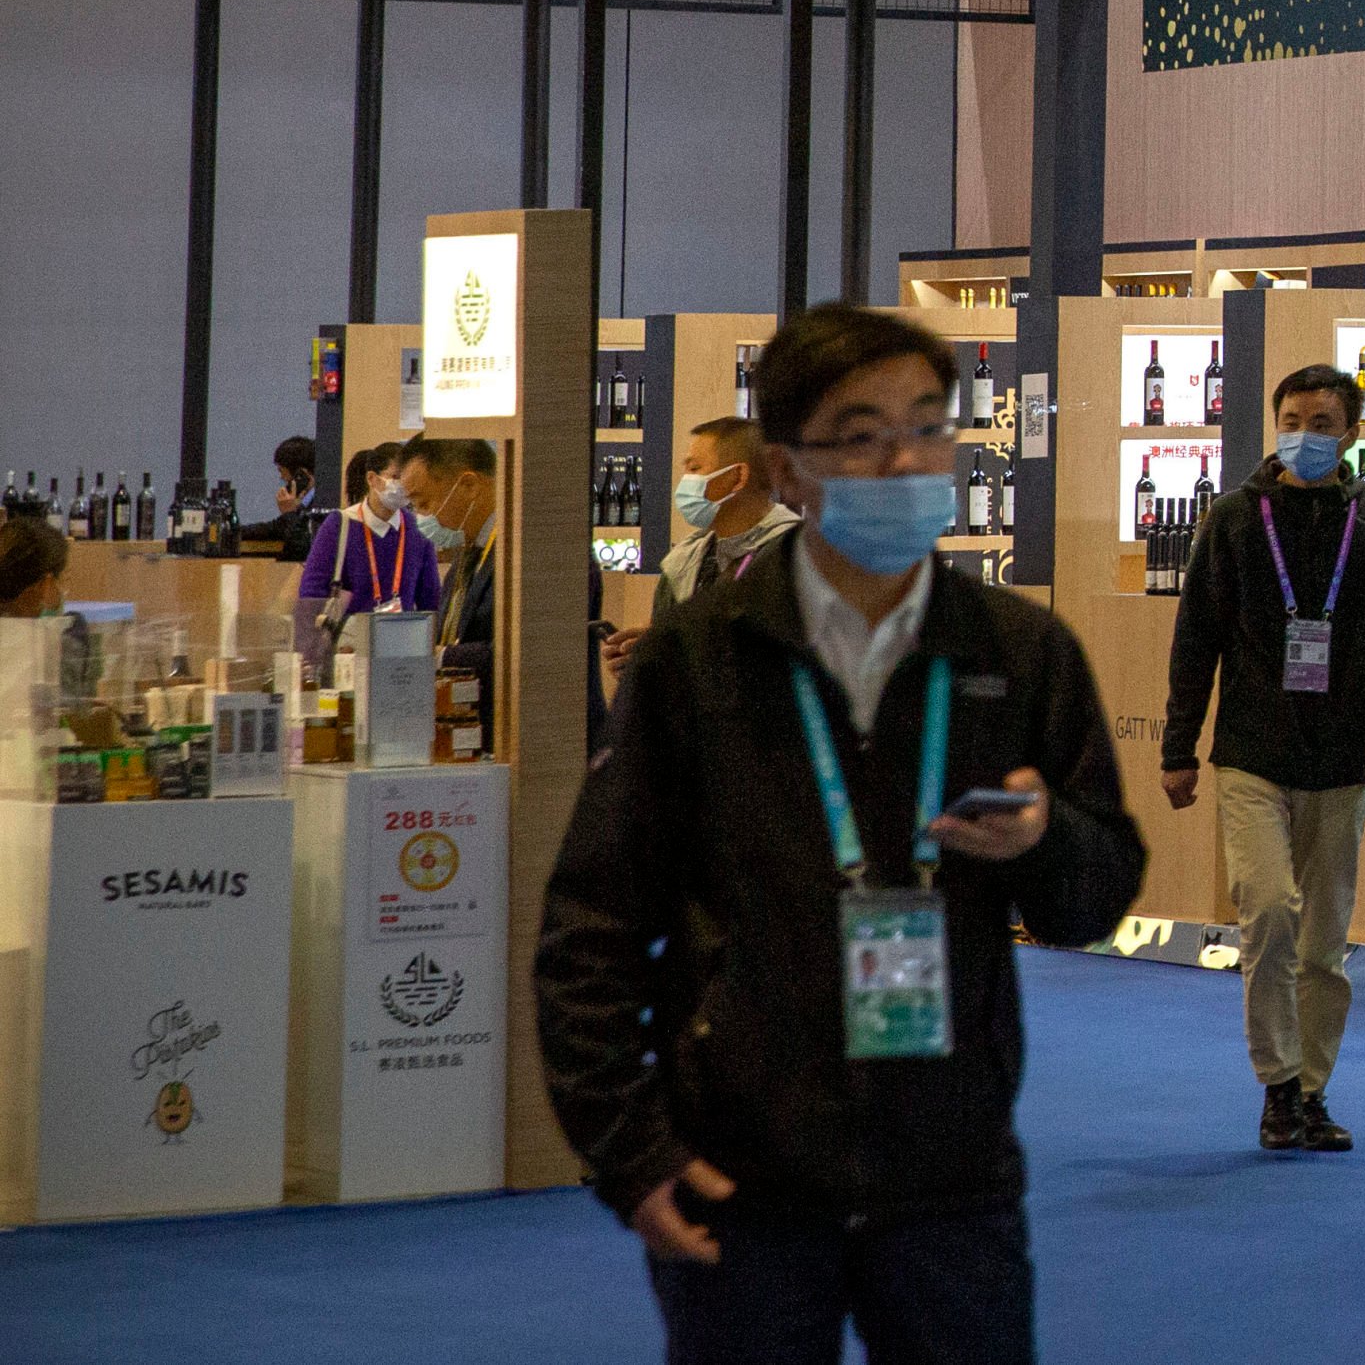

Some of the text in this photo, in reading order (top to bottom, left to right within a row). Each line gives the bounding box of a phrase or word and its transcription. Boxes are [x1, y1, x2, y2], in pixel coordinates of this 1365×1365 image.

[1115, 716, 1147, 741] GATT
[101, 868, 250, 902] SESAMIS
[377, 1035, 440, 1049] PREMIUM
[444, 1031, 492, 1045] FOODS
